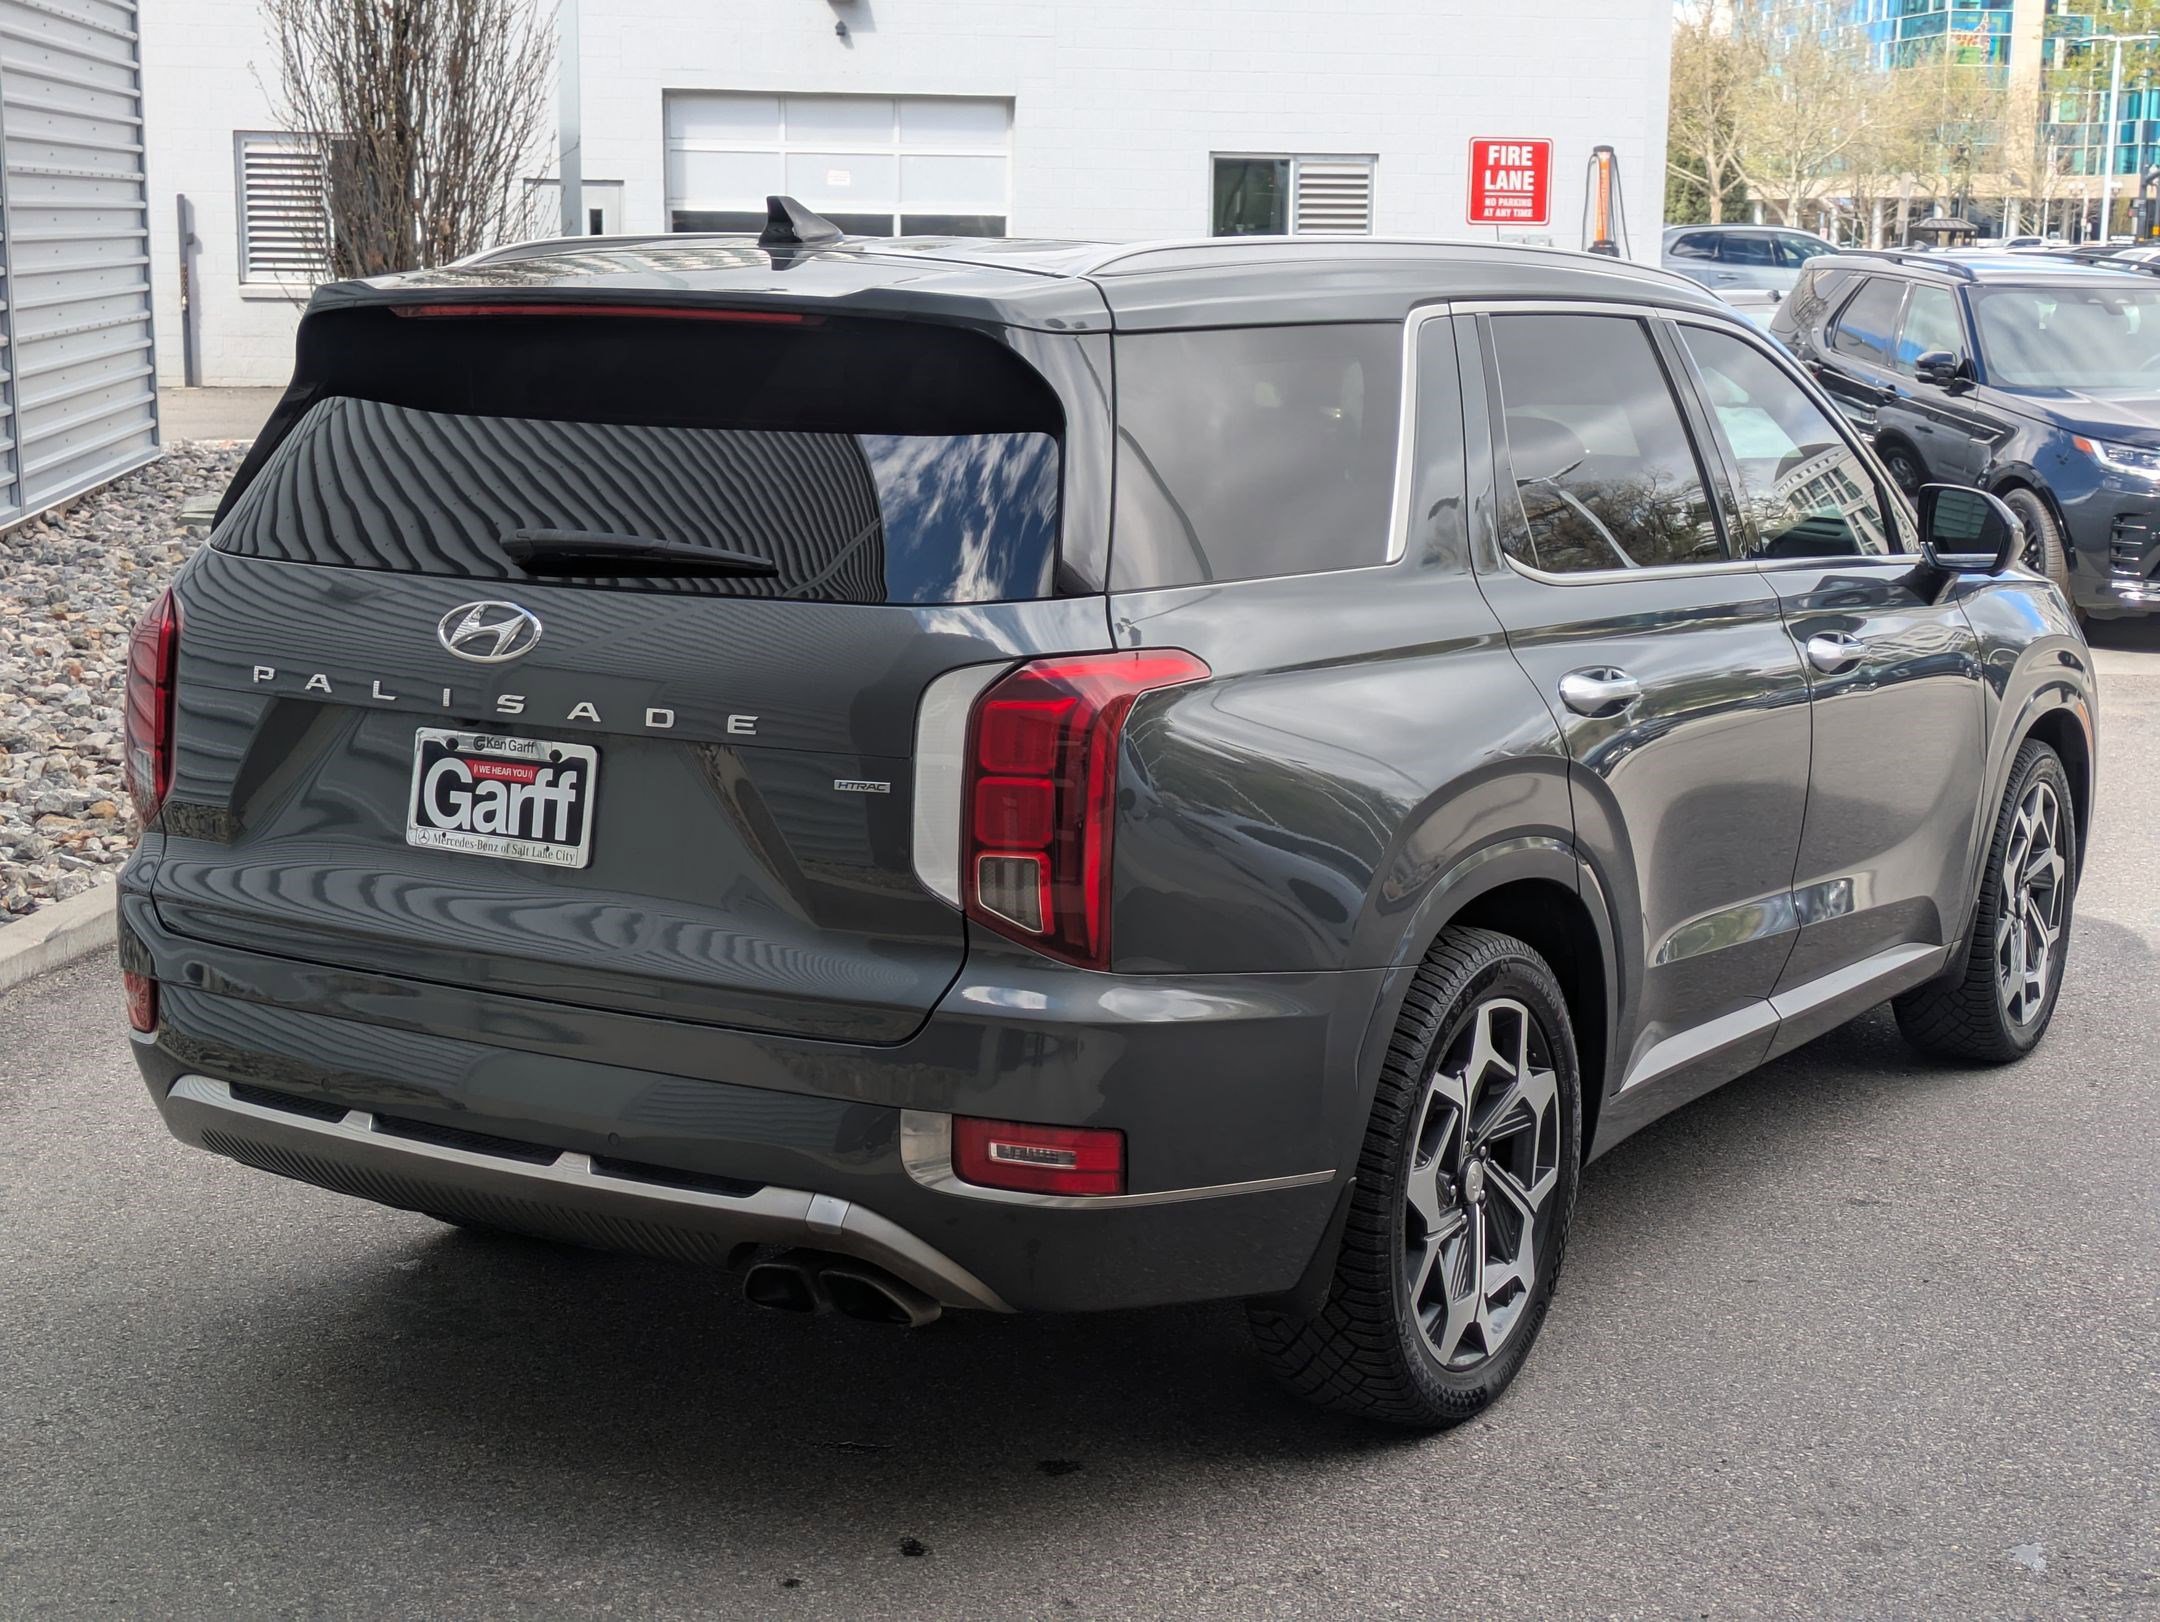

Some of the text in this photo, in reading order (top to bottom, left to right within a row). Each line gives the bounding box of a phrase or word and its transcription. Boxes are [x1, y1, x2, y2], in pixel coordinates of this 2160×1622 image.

[1488, 145, 1533, 166] FIRE
[1484, 169, 1535, 191] LANE
[1485, 197, 1533, 208] NO PARKING
[1483, 207, 1533, 218] AT ANY TIME
[253, 664, 758, 736] PALISADE
[486, 736, 507, 750] Ken
[508, 739, 535, 753] Garff
[479, 765, 528, 778] WE HEAR YOU
[837, 781, 888, 792] HTRAC
[423, 757, 577, 841] Garff
[433, 832, 576, 863] Mercedes-Benz of Salt Lake City
